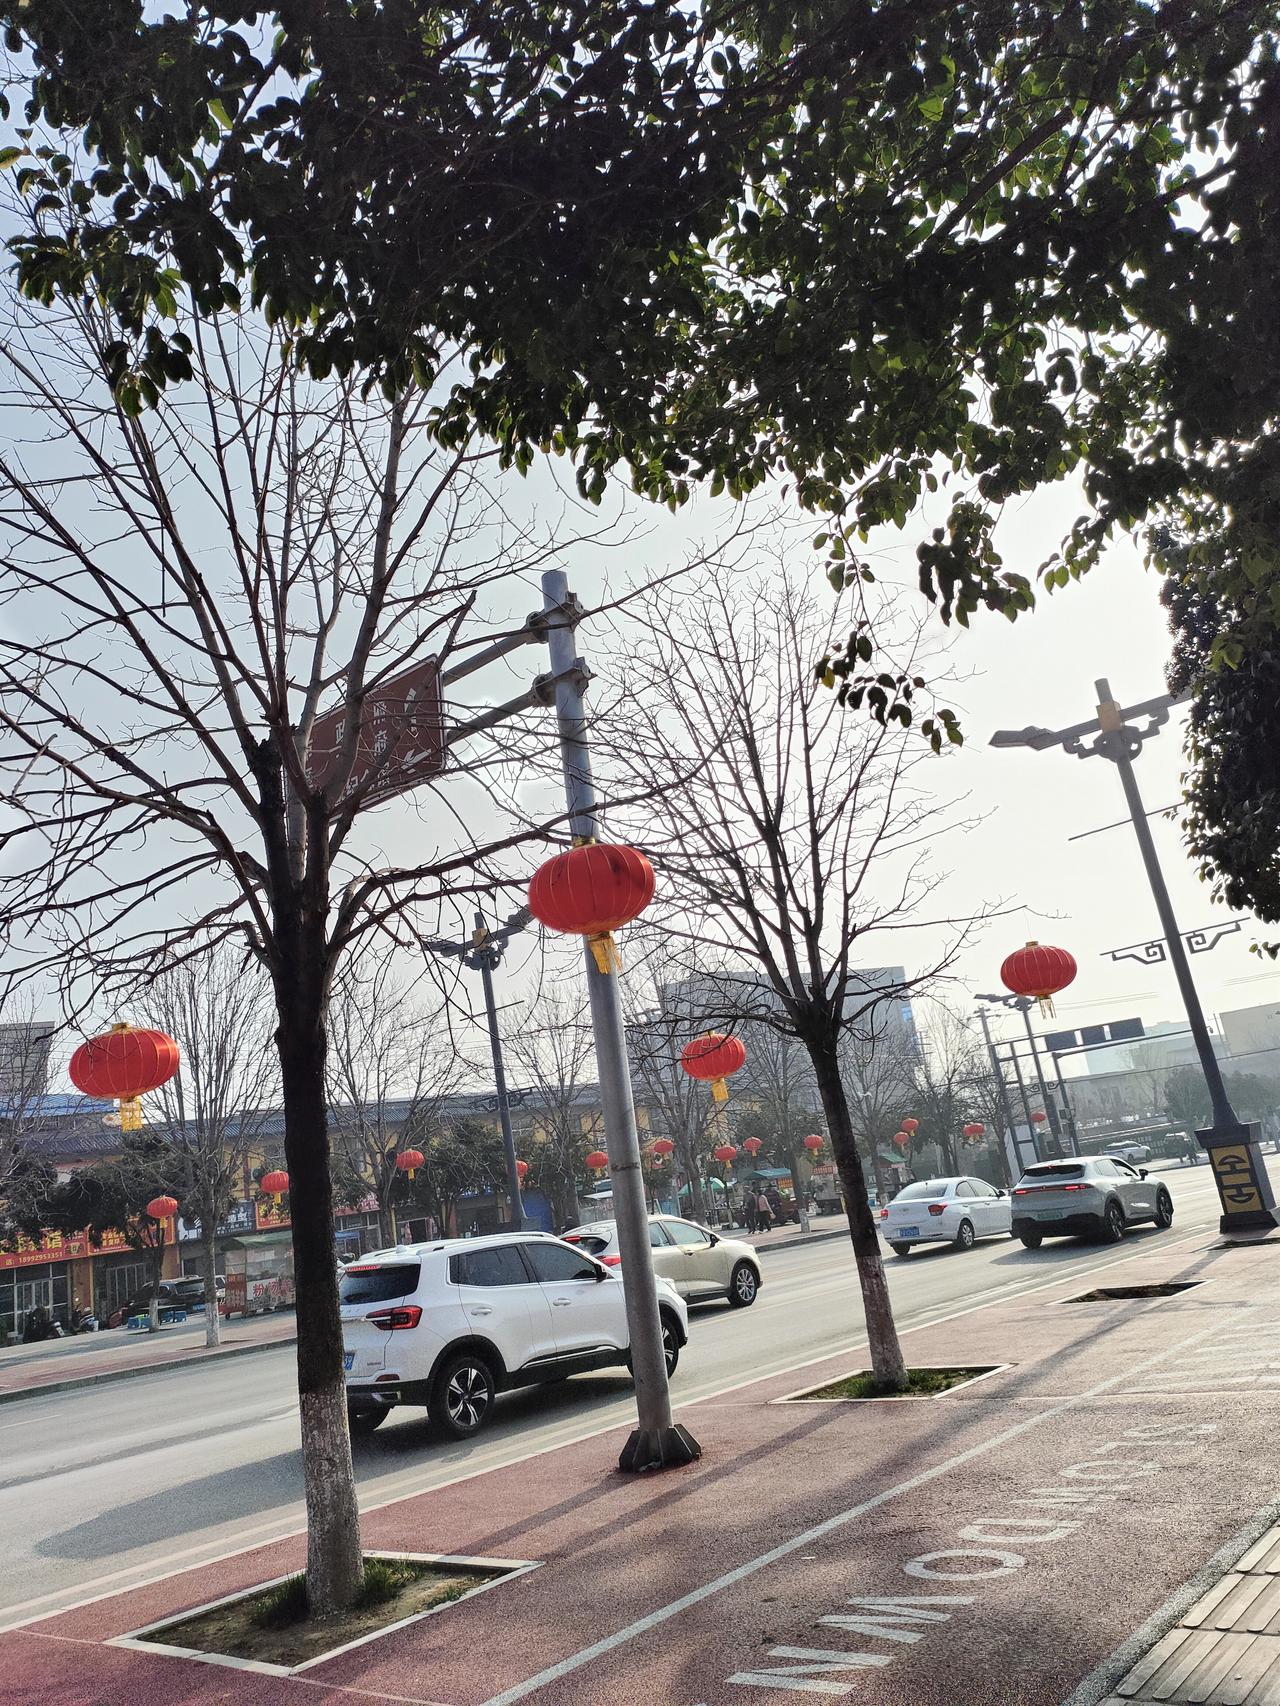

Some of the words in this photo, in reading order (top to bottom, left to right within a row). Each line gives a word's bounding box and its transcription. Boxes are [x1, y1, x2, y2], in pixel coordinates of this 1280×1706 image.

[19, 1250, 64, 1264] 18992953351
[1009, 1423, 1217, 1513] SLOW
[724, 1517, 1085, 1696] DOWN
